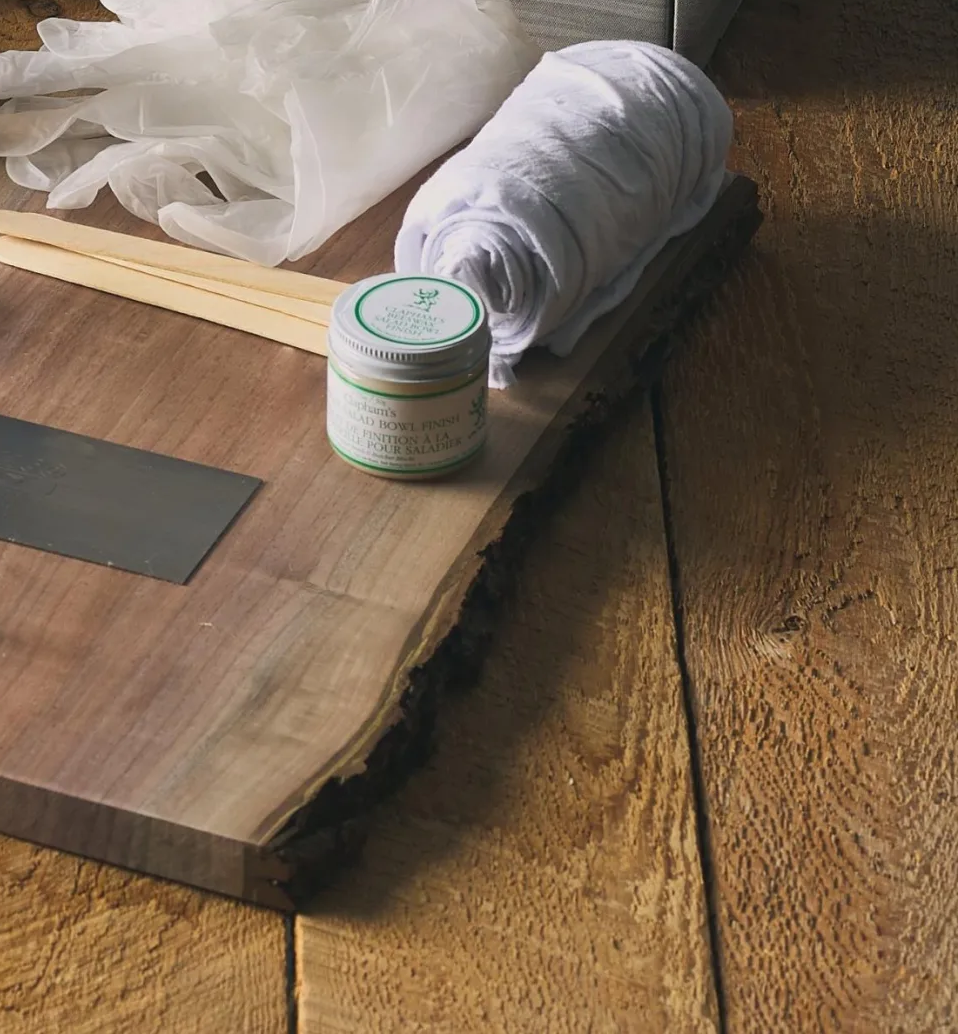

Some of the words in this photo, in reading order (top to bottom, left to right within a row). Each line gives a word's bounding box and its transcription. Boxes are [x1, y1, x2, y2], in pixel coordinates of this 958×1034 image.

[379, 420, 415, 432] BOWL
[422, 413, 460, 431] FINISH
[363, 429, 418, 445] FINITION
[436, 431, 450, 443] LA
[367, 440, 401, 455] POUR
[405, 437, 462, 455] SALADIER
